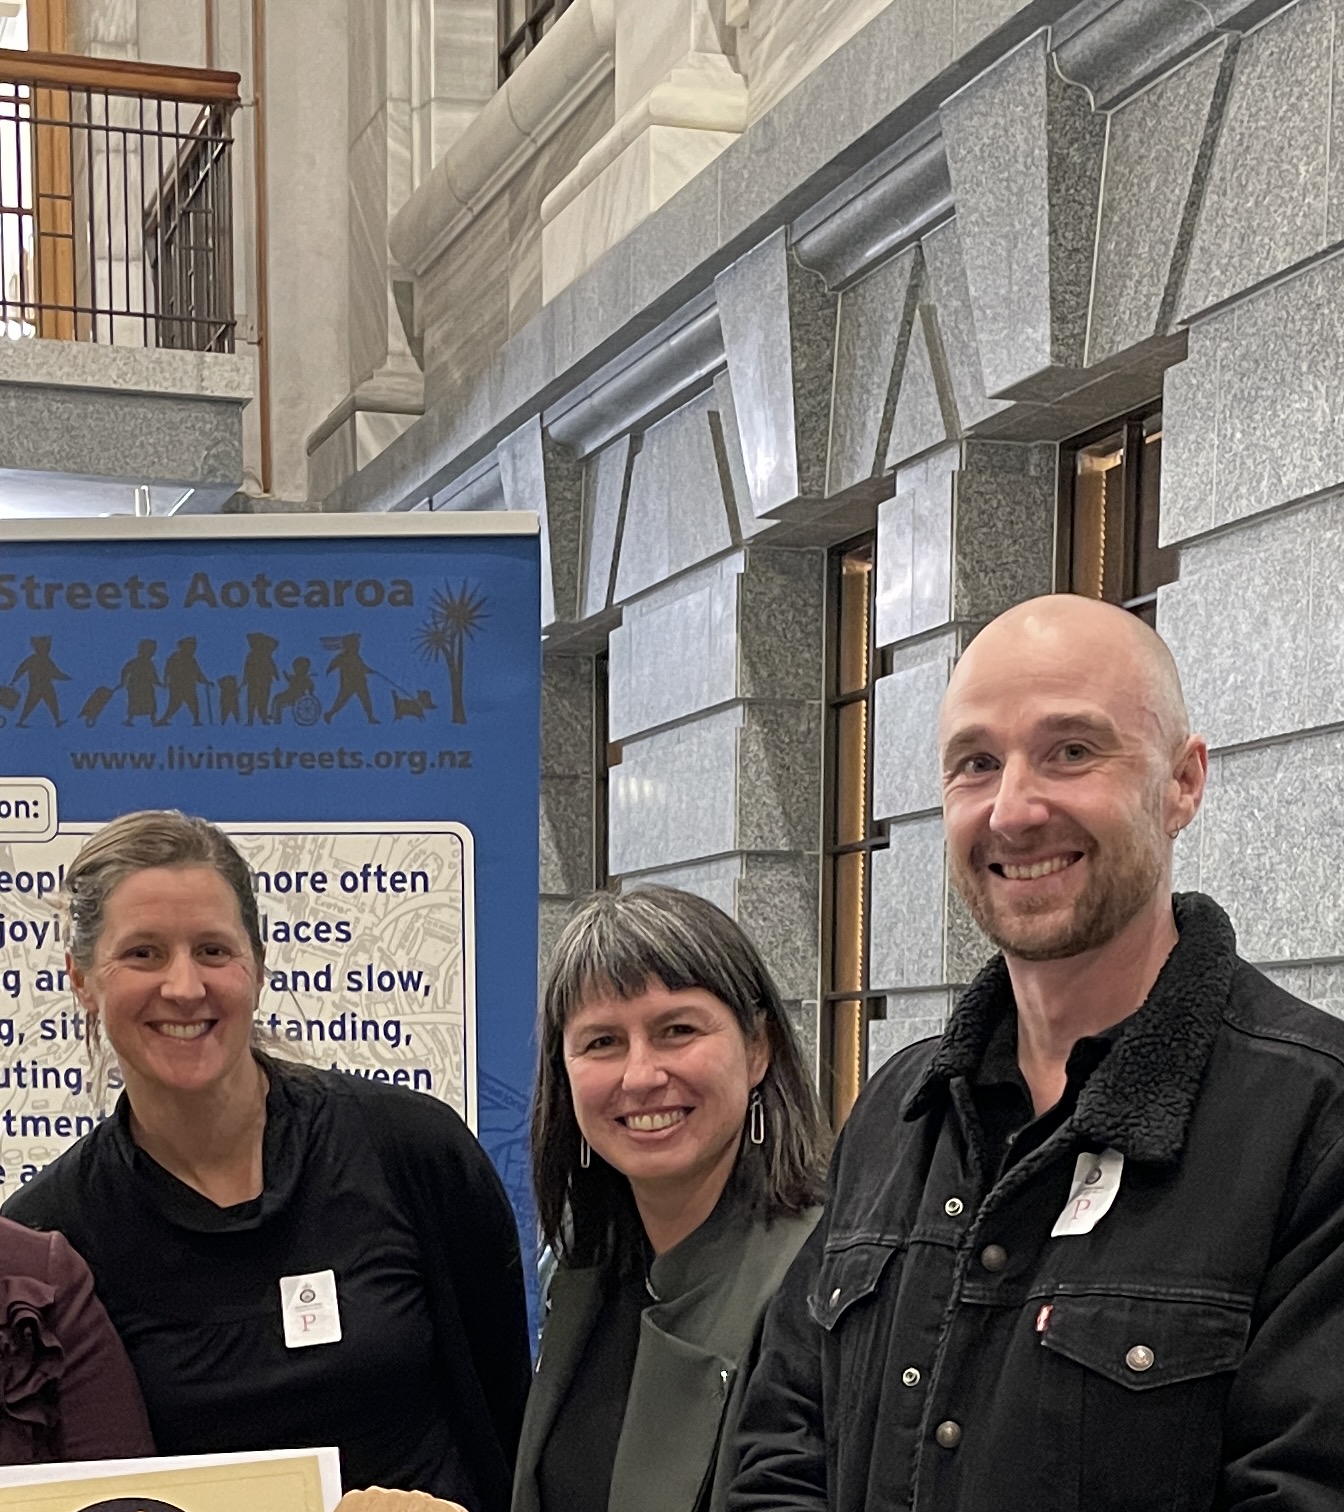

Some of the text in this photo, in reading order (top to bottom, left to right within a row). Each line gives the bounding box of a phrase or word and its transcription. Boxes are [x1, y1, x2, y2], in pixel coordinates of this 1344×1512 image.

[183, 571, 414, 609] Aotearoa
[70, 744, 473, 775] www.livingstreets.org.nz
[339, 863, 430, 893] often
[262, 913, 352, 944] laces
[270, 963, 332, 993] and
[346, 963, 431, 997] slow,
[266, 1011, 412, 1049] tanding,
